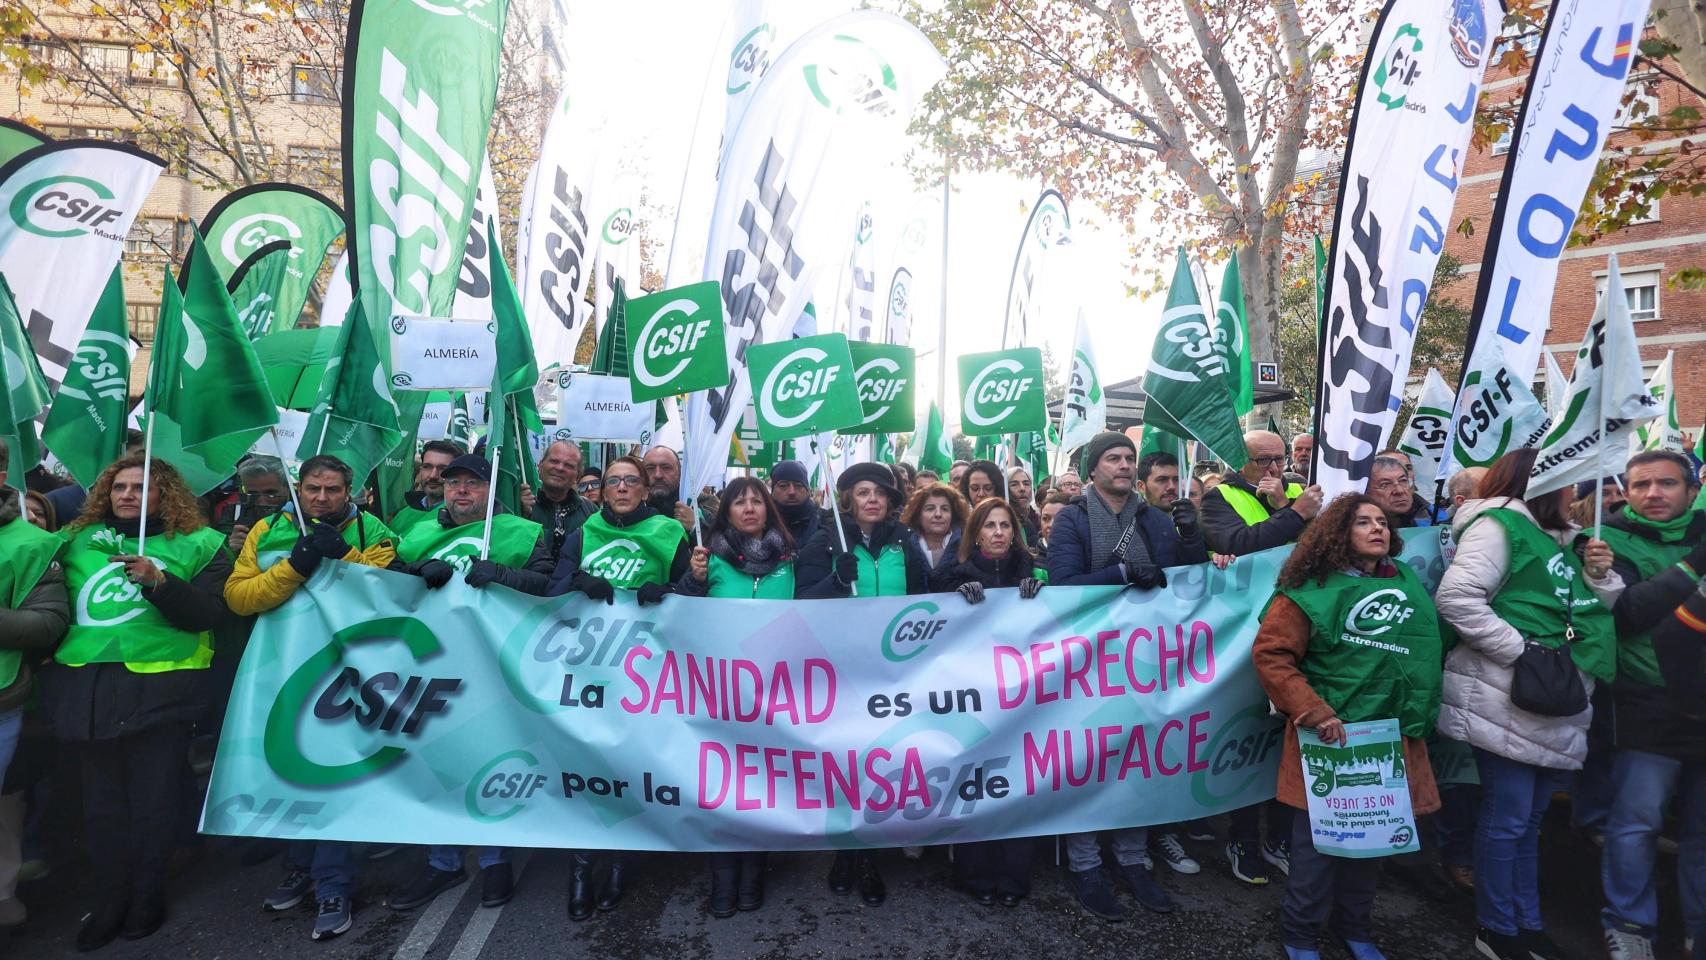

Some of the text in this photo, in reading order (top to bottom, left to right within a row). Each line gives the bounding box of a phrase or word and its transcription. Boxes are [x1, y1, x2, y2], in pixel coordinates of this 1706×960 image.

[369, 46, 471, 317] CSIF
[35, 191, 123, 227] CSIF
[541, 164, 589, 330] CSIF
[424, 347, 479, 359] ALMERÍA
[647, 319, 711, 359] CSIF
[72, 346, 128, 401] CSIF
[776, 365, 840, 402] CSIF
[858, 378, 907, 402] CSIF
[977, 377, 1033, 404] CSIF
[86, 404, 107, 433] Madrid
[420, 412, 439, 420] ERÍA
[584, 401, 631, 412] ALMERÍA
[593, 556, 647, 582] CSIF
[532, 616, 656, 668] CSIF
[894, 619, 948, 643] CSIF
[1341, 632, 1410, 656] Extremadura
[560, 620, 1216, 726] La SANIDAD es un DERECHO
[314, 666, 463, 734] CSIF
[561, 710, 1211, 812] por la DEFENSA de MUFACE
[1212, 726, 1284, 777] CSIF
[481, 772, 548, 800] CSIF
[210, 793, 327, 838] SIF
[1325, 794, 1395, 809] NO SE JUEGA
[1336, 820, 1348, 829] de
[1351, 820, 1375, 829] salud
[1388, 817, 1405, 825] Con
[1388, 832, 1410, 844] CSIF
